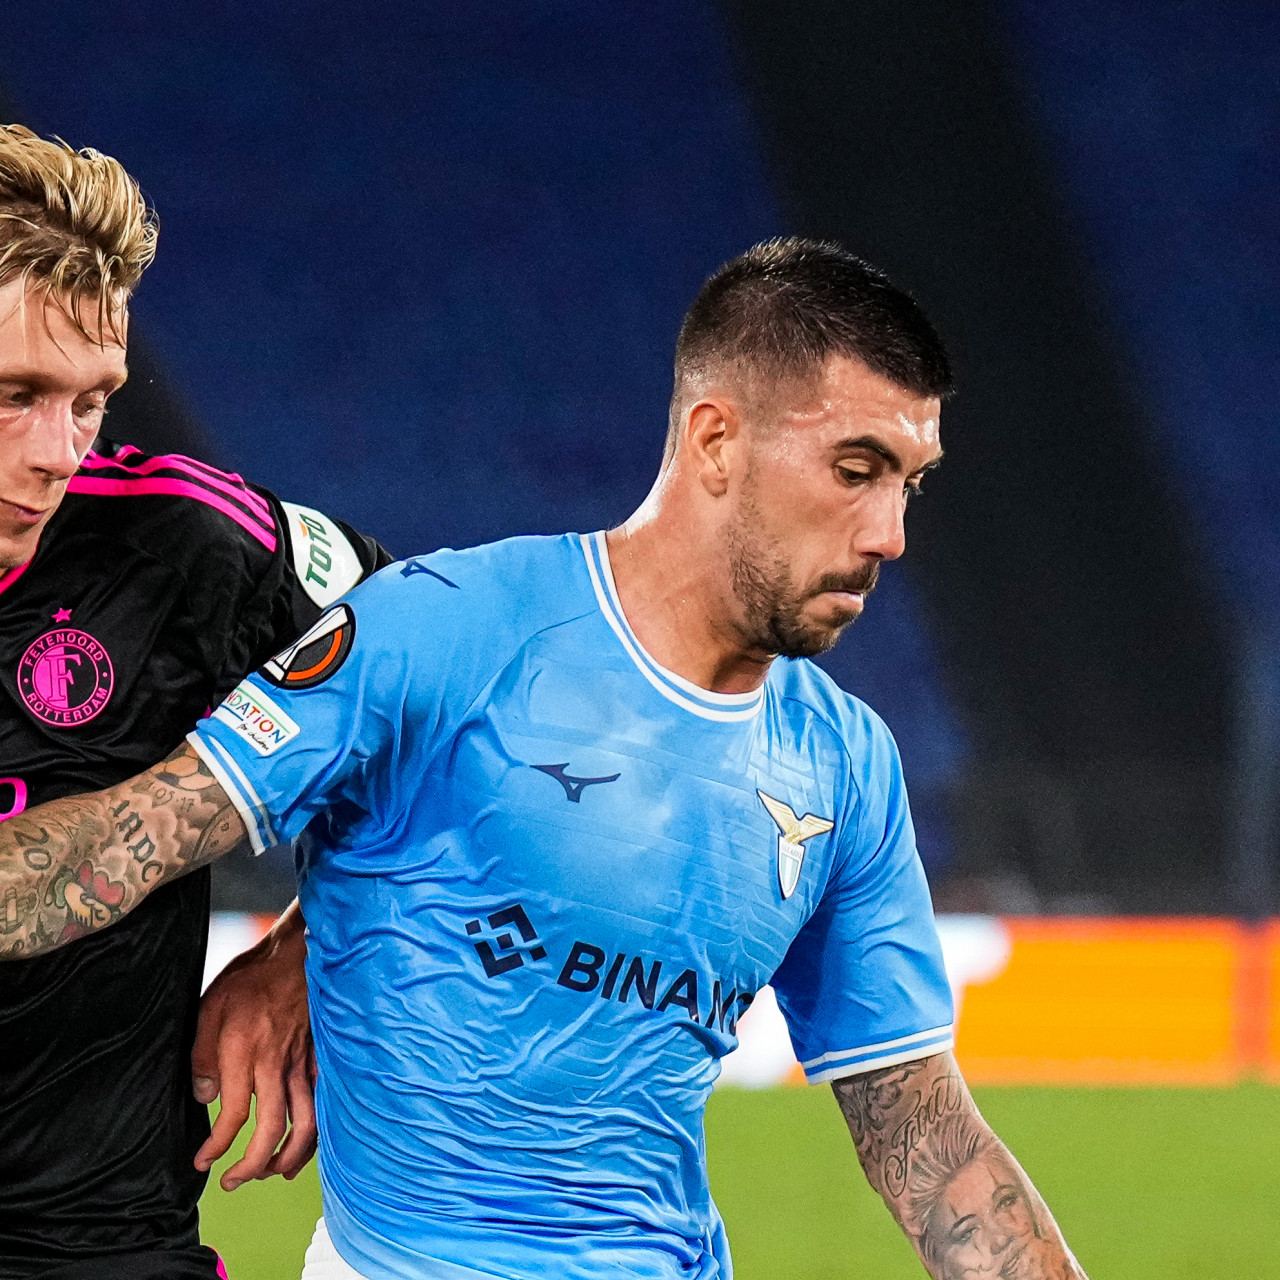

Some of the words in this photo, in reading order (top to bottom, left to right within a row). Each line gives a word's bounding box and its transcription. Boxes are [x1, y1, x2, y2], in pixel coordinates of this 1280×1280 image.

[298, 512, 333, 590] TOTO
[24, 632, 105, 668] FEYENOORD
[26, 687, 108, 723] ROTTERDAM
